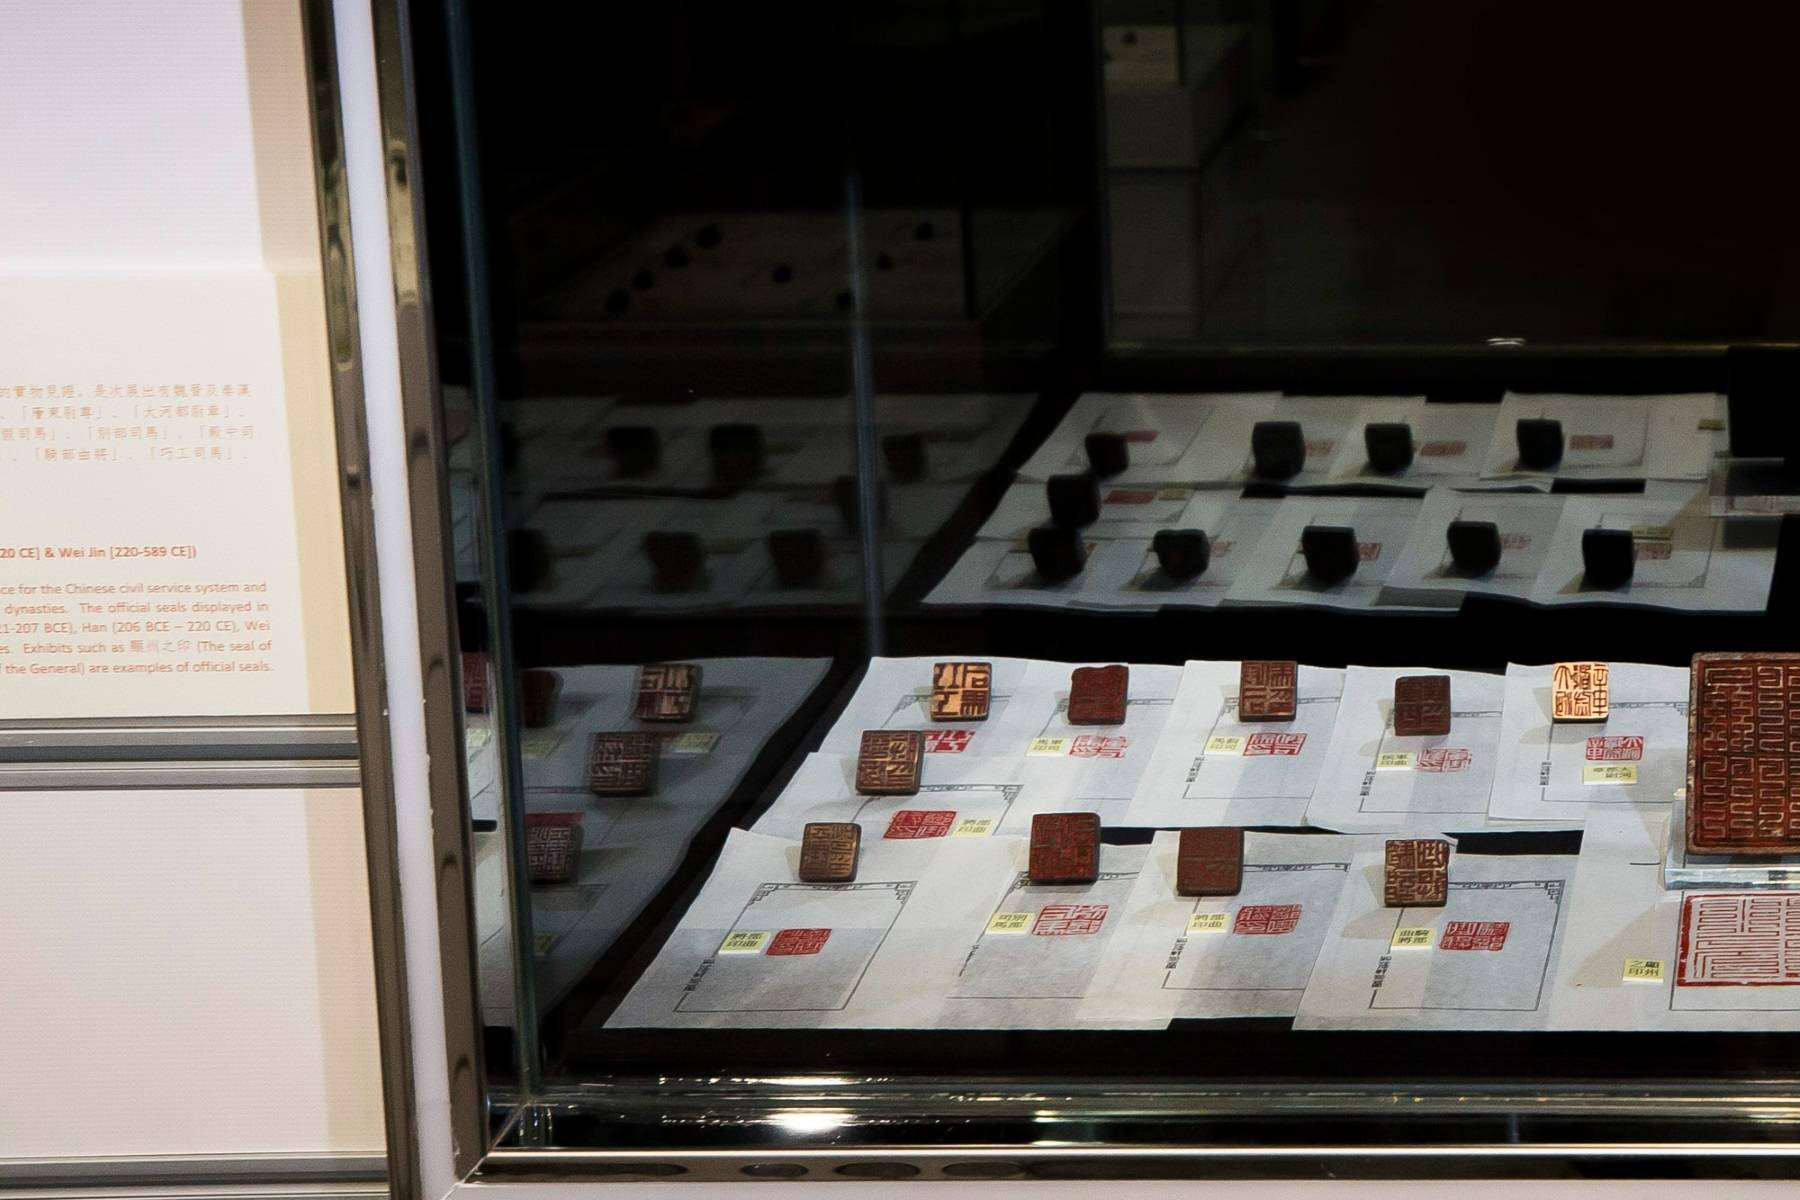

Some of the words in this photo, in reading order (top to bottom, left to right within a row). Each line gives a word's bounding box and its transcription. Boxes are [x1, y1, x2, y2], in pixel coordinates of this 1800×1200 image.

[19, 546, 40, 560] CE]
[44, 546, 54, 559] &
[59, 546, 85, 558] Wei
[88, 545, 106, 558] Jin
[110, 545, 167, 560] [220-589
[19, 584, 37, 595] for
[40, 584, 62, 595] the
[65, 583, 116, 594] Chinese
[119, 582, 144, 594] civil
[147, 582, 192, 594] service
[194, 582, 240, 595] system
[243, 581, 267, 593] and
[79, 602, 103, 614] The
[107, 601, 151, 614] official
[156, 601, 187, 613] seals
[191, 601, 252, 615] displayed
[256, 601, 269, 612] in
[82, 621, 108, 633] Han
[111, 620, 141, 635] (206
[146, 620, 170, 632] BCE
[187, 620, 212, 632] 220
[245, 620, 271, 631] Wei
[23, 642, 73, 654] Exhibits
[77, 641, 106, 653] such
[111, 643, 125, 653] as
[197, 639, 226, 654] (The
[229, 639, 255, 652] seal
[258, 639, 272, 652] of
[5, 663, 26, 674] the
[30, 662, 85, 676] General)
[88, 663, 110, 674] are
[112, 662, 173, 675] examples
[176, 661, 190, 673] of
[192, 660, 236, 673] official
